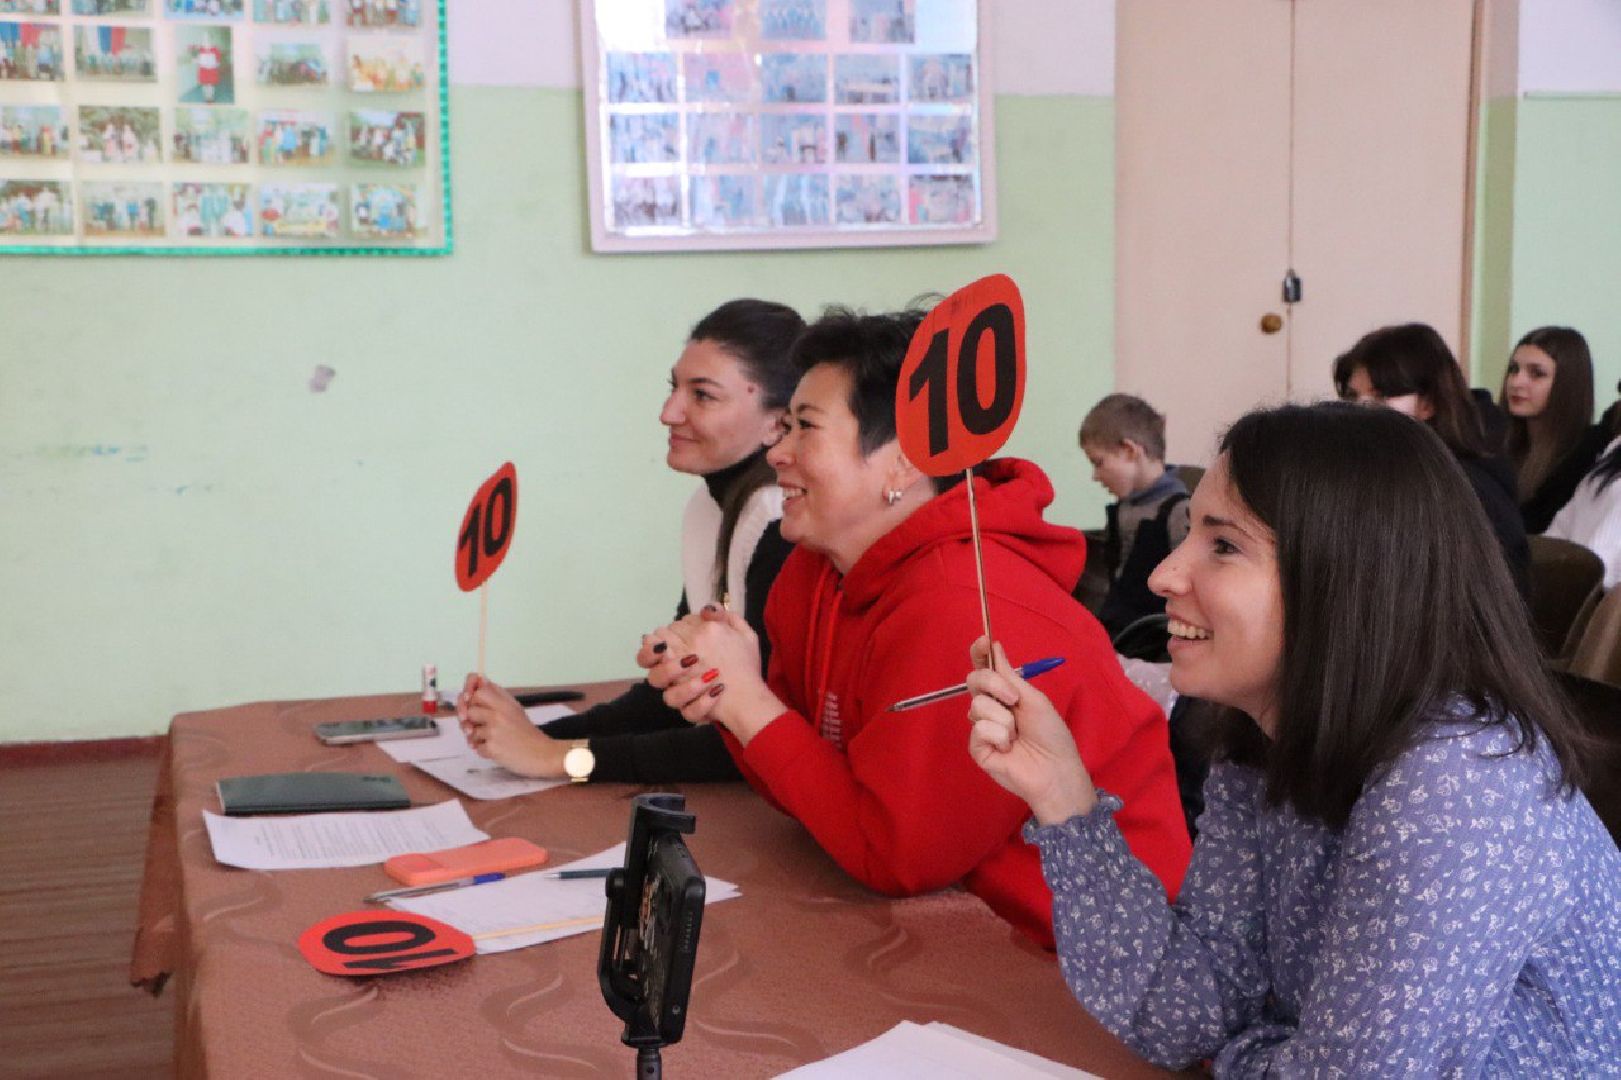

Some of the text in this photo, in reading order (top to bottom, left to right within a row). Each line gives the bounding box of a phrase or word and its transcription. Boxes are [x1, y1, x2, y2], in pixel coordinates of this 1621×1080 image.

[909, 303, 1016, 458] 10
[460, 477, 512, 578] 10
[323, 920, 459, 969] 10
